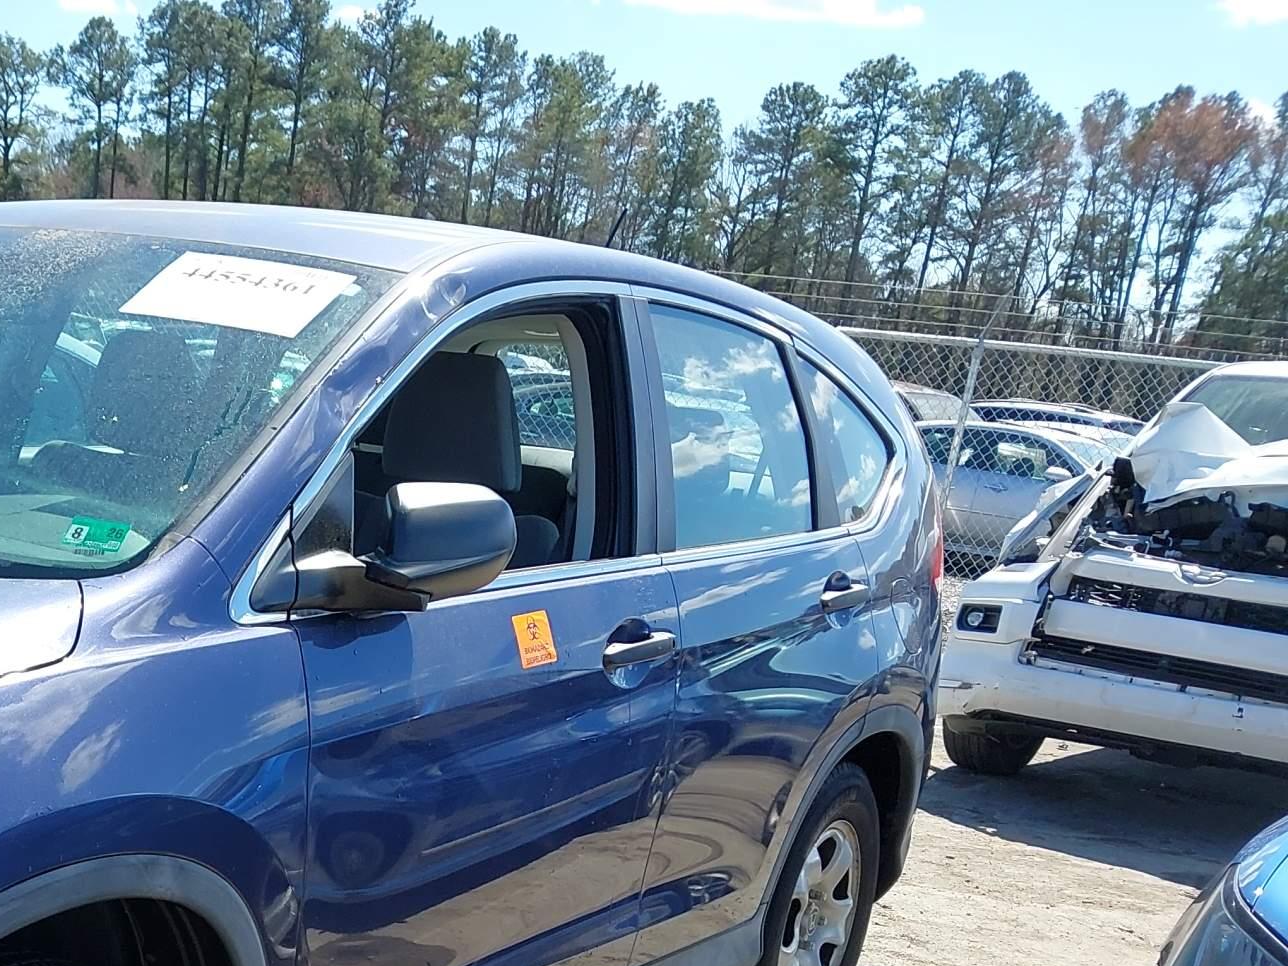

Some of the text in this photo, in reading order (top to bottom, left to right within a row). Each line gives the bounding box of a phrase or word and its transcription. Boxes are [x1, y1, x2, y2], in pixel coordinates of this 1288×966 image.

[183, 267, 316, 295] 44554361
[71, 527, 84, 540] 8
[106, 527, 125, 539] 26
